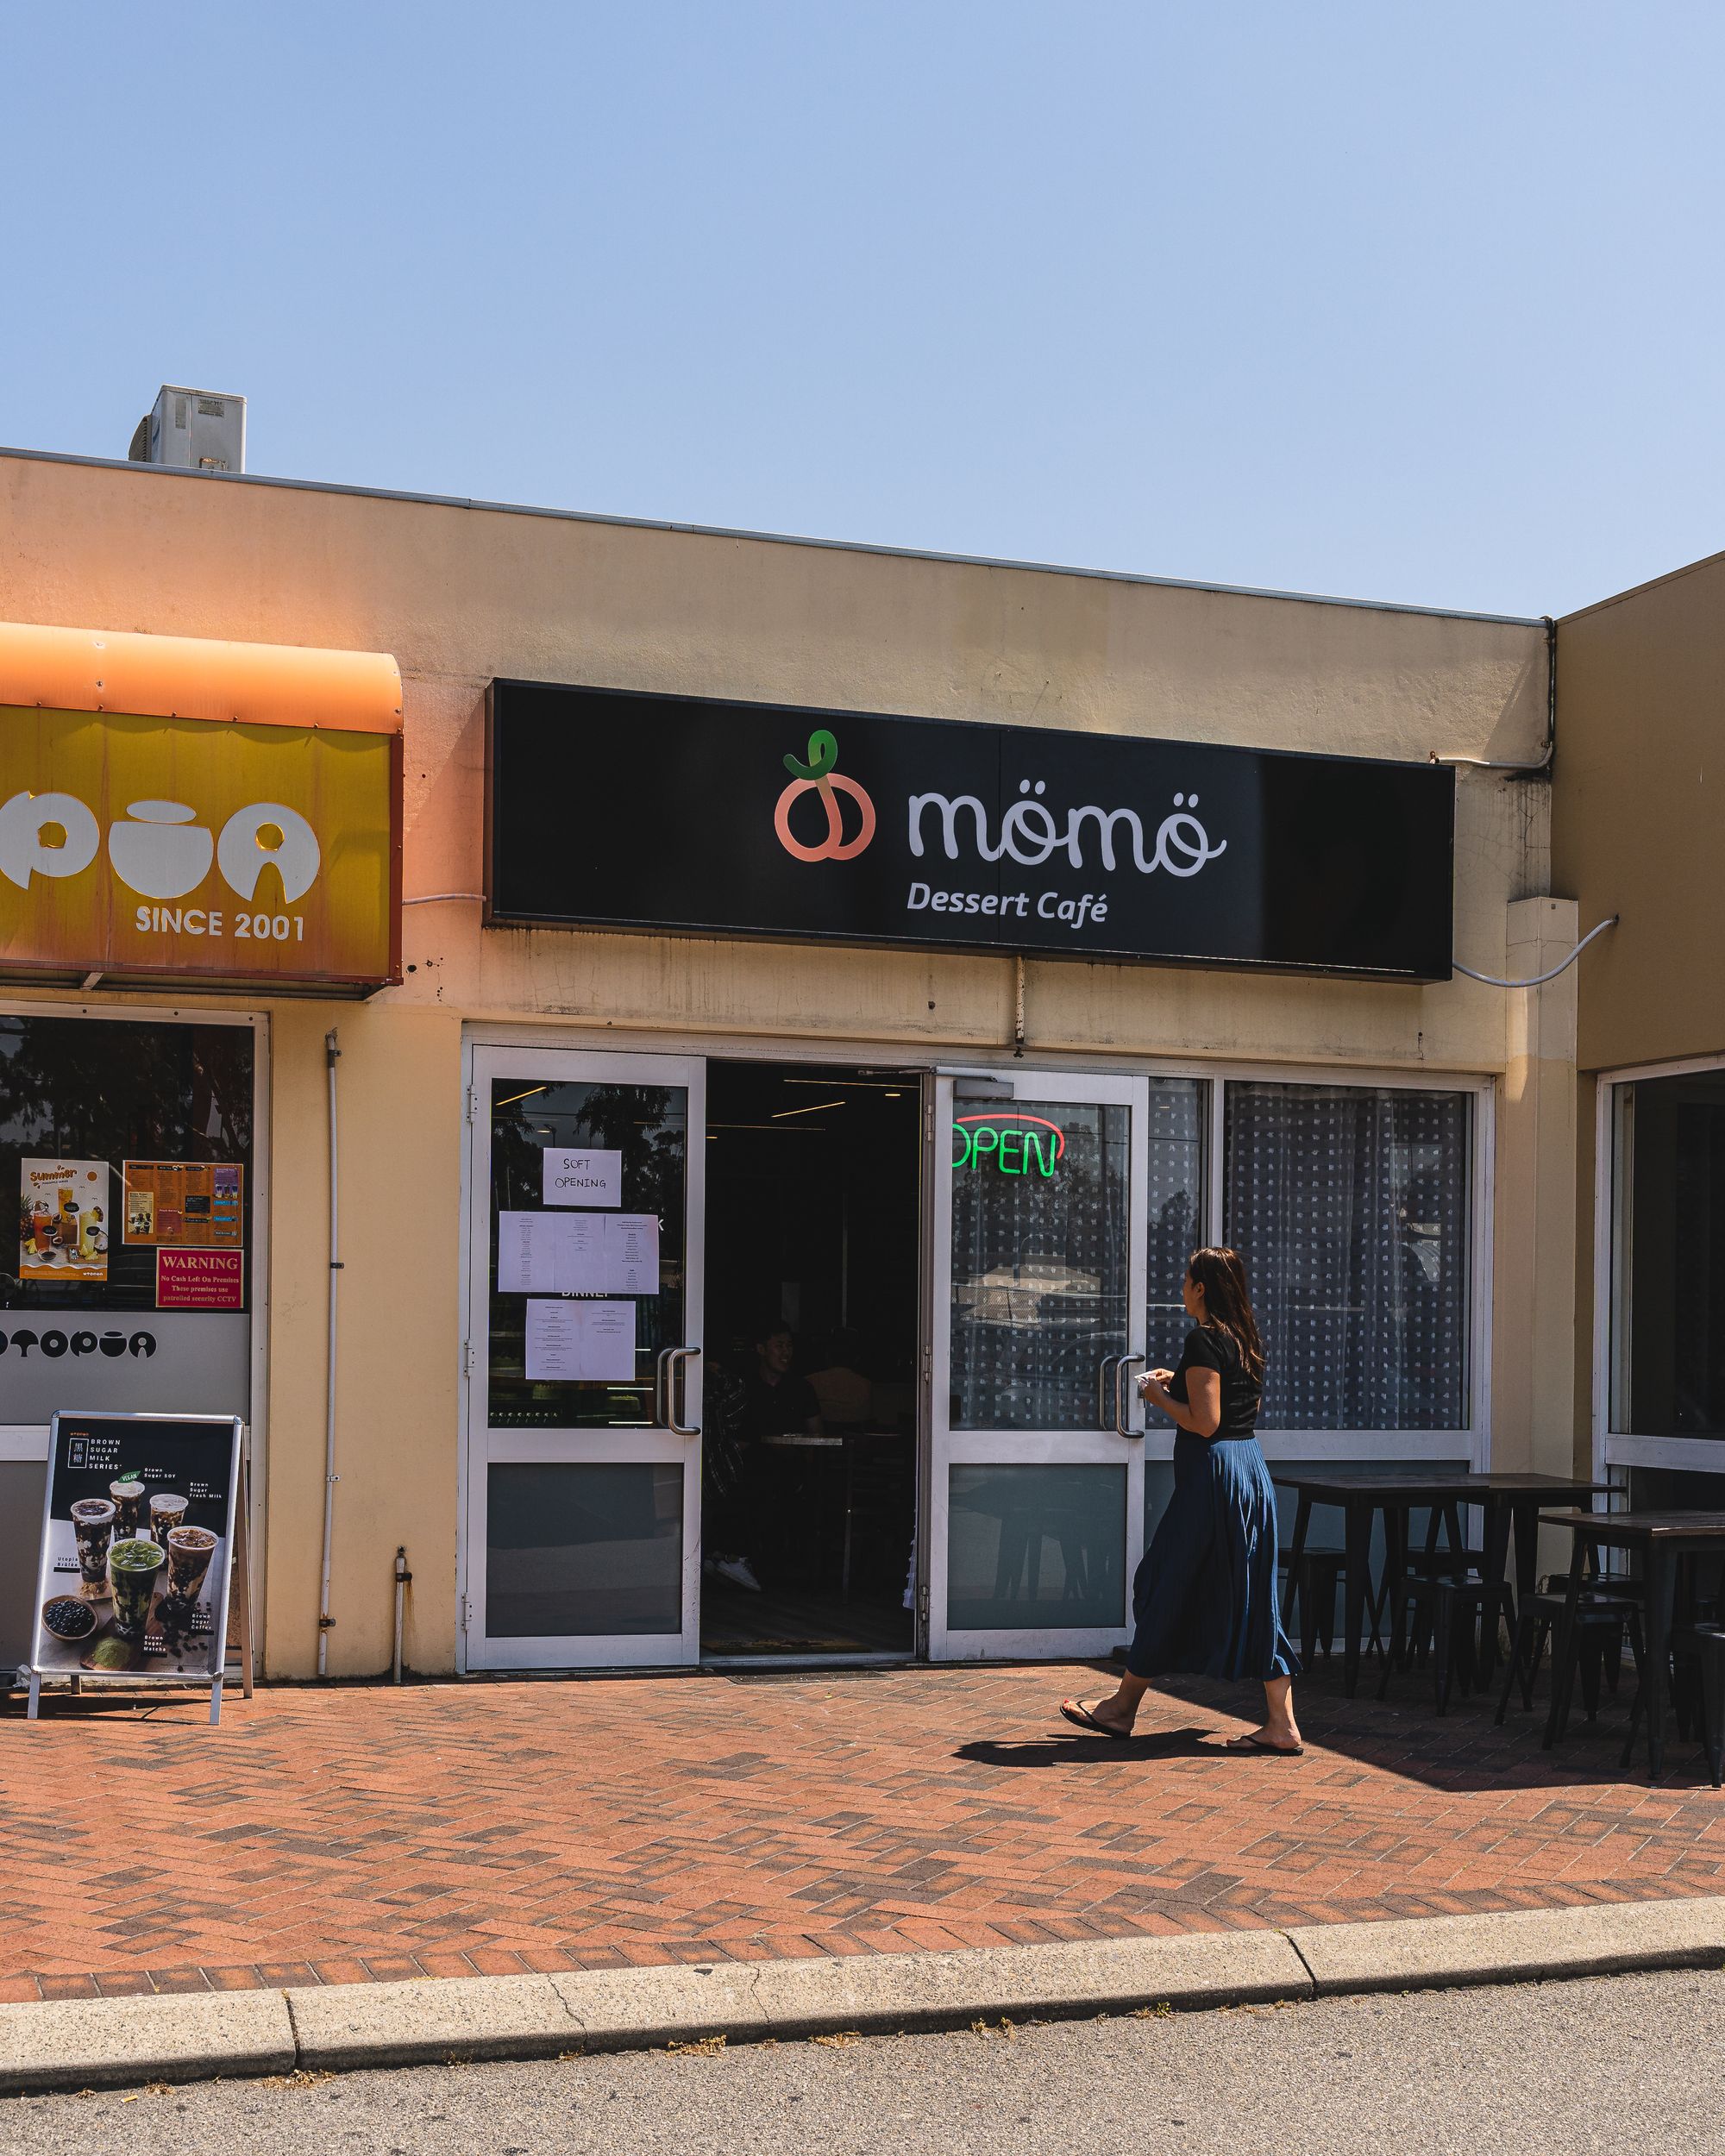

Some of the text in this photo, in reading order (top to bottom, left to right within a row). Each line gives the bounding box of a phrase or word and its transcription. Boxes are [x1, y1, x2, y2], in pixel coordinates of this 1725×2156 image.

[908, 779, 1226, 877] mömö
[907, 882, 1108, 930] Dessert Café
[135, 906, 304, 942] SINCE 2001
[563, 1158, 591, 1169] SOFT
[30, 1169, 78, 1181] Summer
[555, 1177, 606, 1188] OPENING
[162, 1257, 238, 1269] WARNING
[0, 1329, 157, 1358] TOPIA
[122, 1473, 137, 1482] VEGAN
